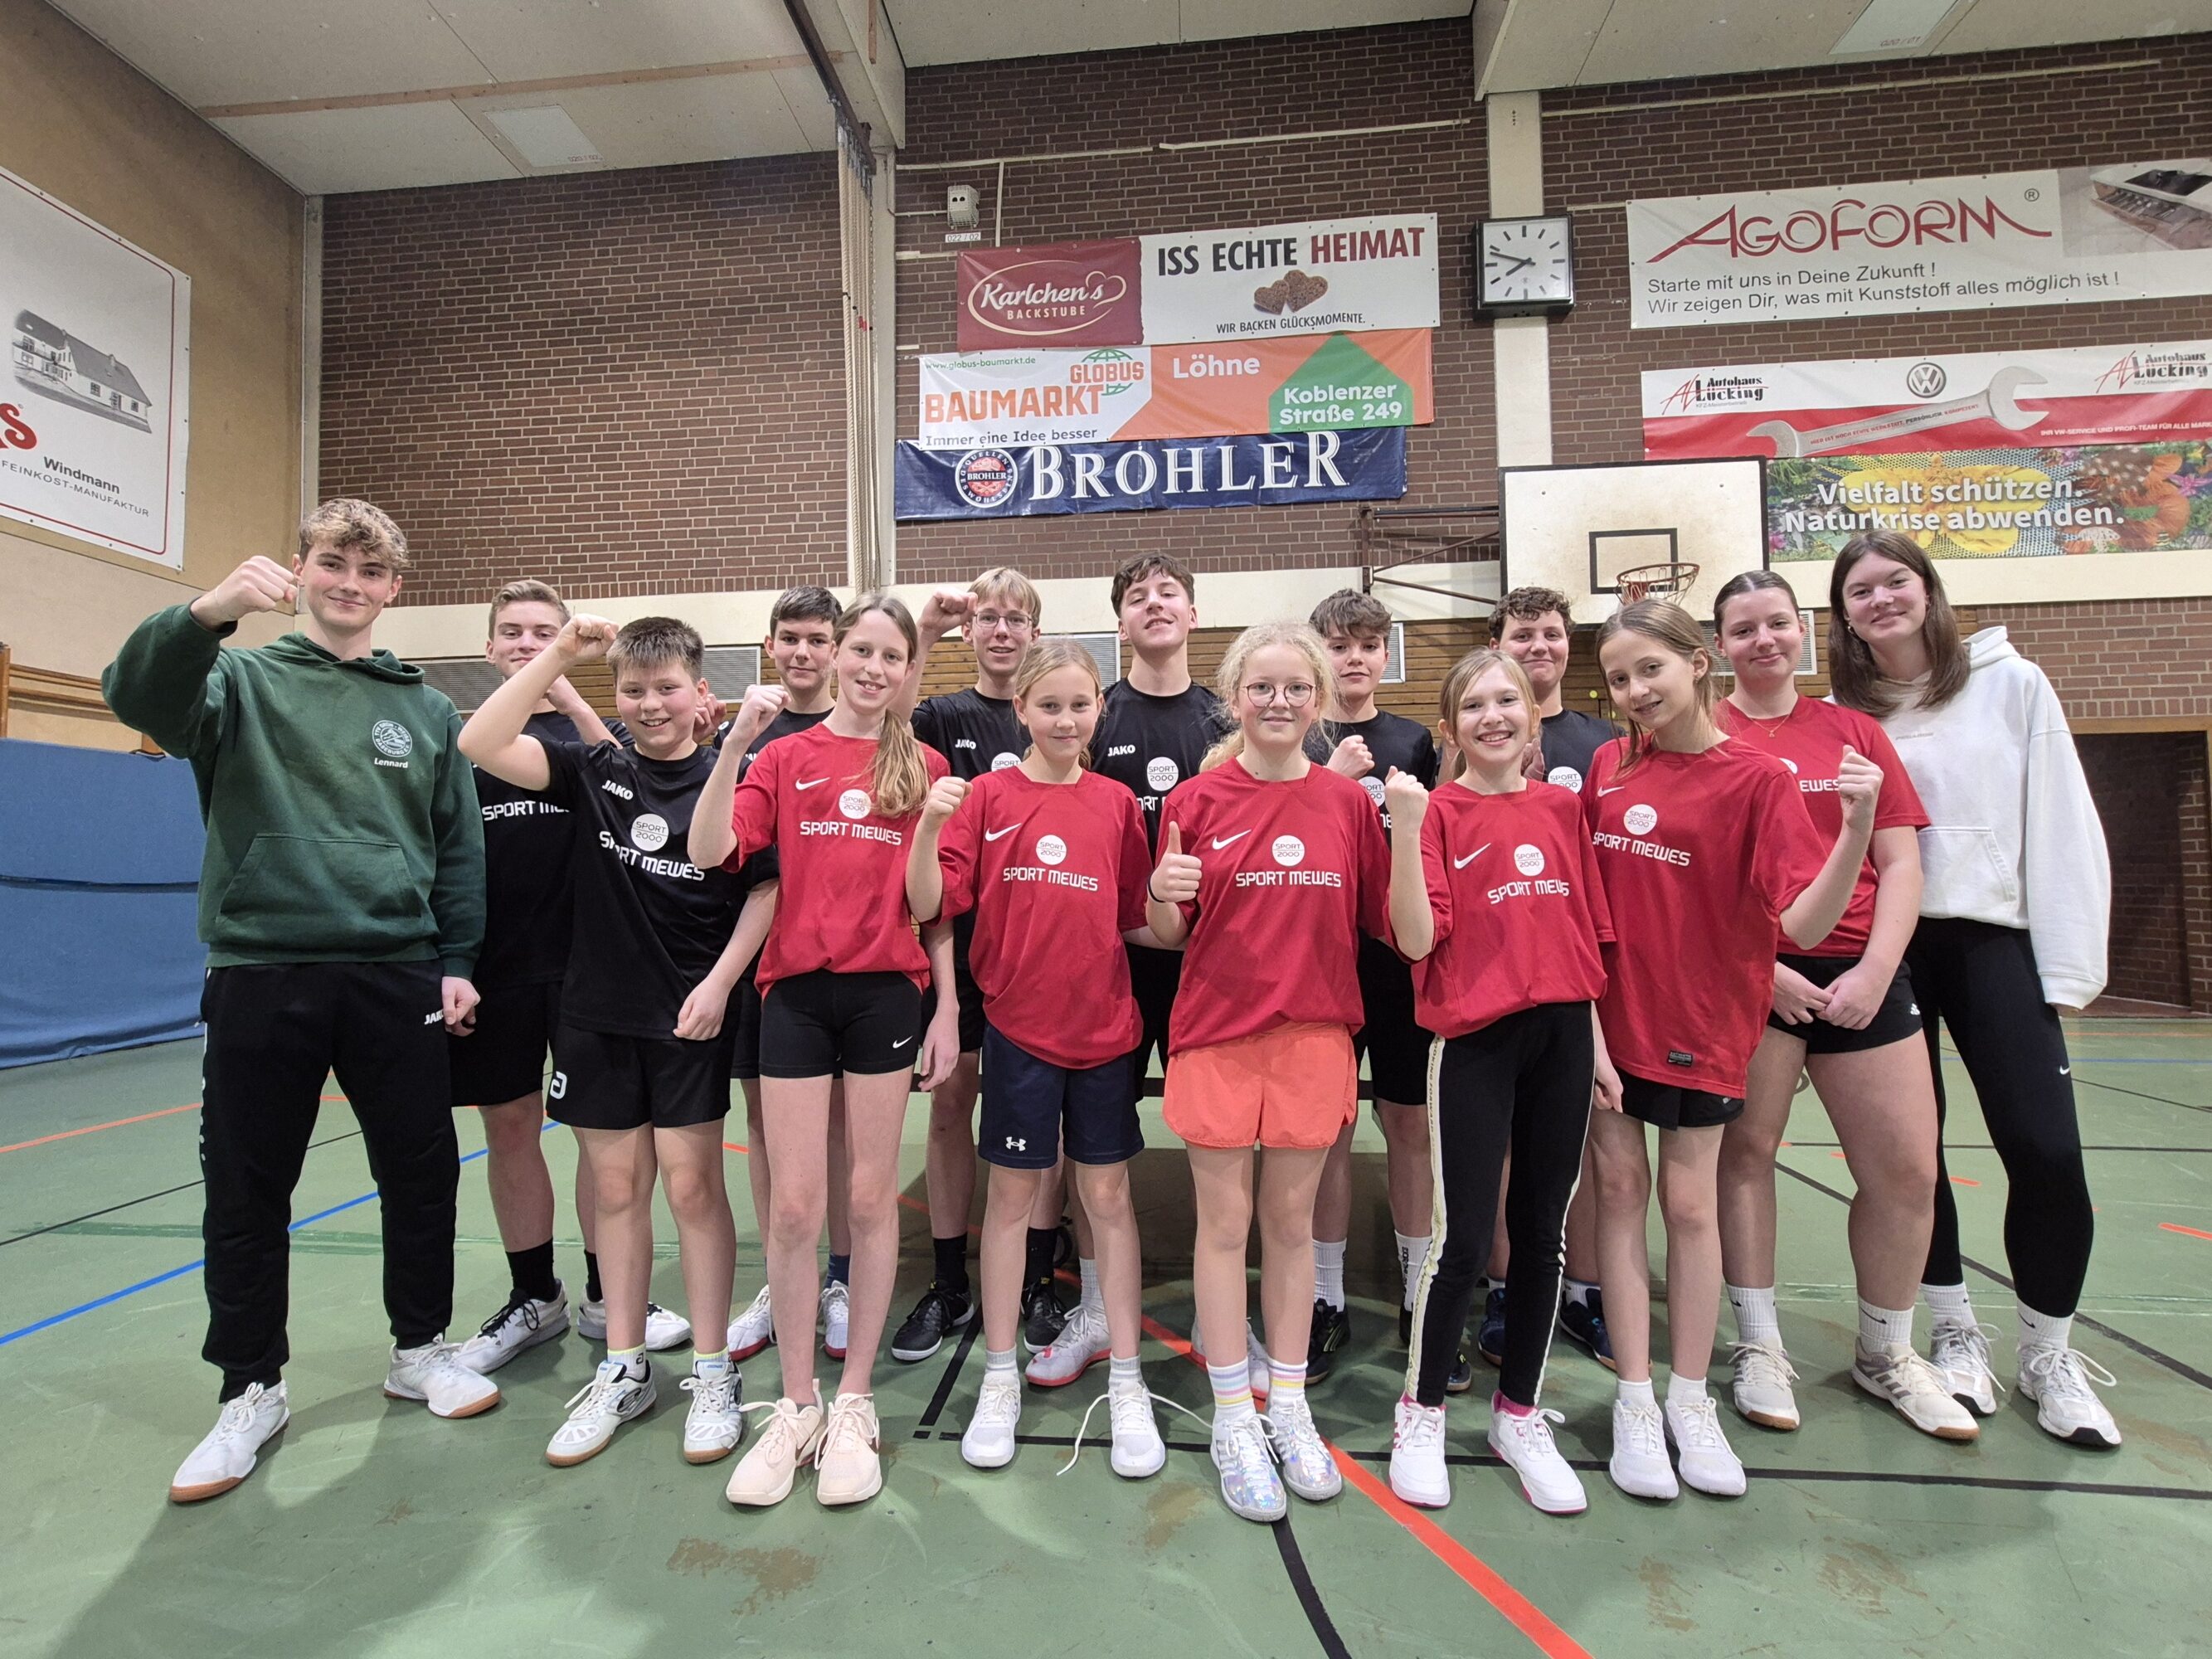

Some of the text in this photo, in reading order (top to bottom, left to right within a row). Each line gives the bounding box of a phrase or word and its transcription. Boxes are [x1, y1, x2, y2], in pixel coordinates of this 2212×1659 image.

[1646, 195, 2052, 263] AGOFORM
[1159, 227, 1425, 276] ISS ECHTE HEIMAT
[1648, 279, 1700, 293] Starte
[1707, 275, 1732, 290] mit
[1739, 275, 1772, 289] uns
[1777, 272, 1791, 285] in
[1798, 269, 1850, 284] Deine
[1856, 263, 1925, 281] Zukunft
[980, 282, 1105, 309] Karlchen's
[1648, 299, 1678, 314] Wir
[1684, 296, 1742, 314] zeigen
[1749, 293, 1777, 309] Dir,
[1785, 293, 1820, 305] was
[1826, 289, 1853, 304] mit
[1860, 282, 1950, 301] Kunststoff
[1957, 281, 1999, 295] alles
[2006, 274, 2080, 294] möglich
[2087, 272, 2109, 287] ist
[1007, 305, 1086, 320] BACKSTUBE
[1216, 313, 1365, 333] WIR BACKEN GLÜCKSMOMENTE.
[925, 357, 1036, 371] www.globus-baumarkt.de
[1173, 354, 1261, 378] Löhne
[2145, 353, 2206, 363] Autohaus
[1070, 361, 1145, 383] GLOBUS
[1707, 377, 1762, 387] Autohaus
[1285, 384, 1397, 405] Koblenzer
[1695, 380, 1763, 401] Lücking
[925, 384, 1104, 423] BAUMARKT
[1280, 401, 1403, 426] Straße 249
[926, 429, 1097, 446] Immer eine Idee besser
[965, 451, 1009, 465] QUELLEN
[1028, 431, 1350, 501] BROHLER
[43, 455, 121, 495] Windmann
[967, 472, 1007, 480] BROHLER
[2, 460, 149, 518] FEINKOST-MANUFAKTUR
[1817, 478, 2083, 506] Vielfalt schützen.
[1785, 503, 2124, 533] Naturkrise abwenden.
[955, 739, 977, 750] JAKO
[1107, 745, 1136, 757] JAKO
[374, 757, 408, 768] Lennard
[601, 779, 634, 800] JAKO
[1799, 780, 1840, 791] EWES
[481, 800, 536, 821] SPORT
[1630, 810, 1655, 820] SPORT
[636, 821, 667, 834] SPORT
[800, 821, 902, 846] SPORT MEWES
[1627, 820, 1650, 828] 2000
[635, 831, 663, 843] 2000
[1040, 841, 1063, 851] SPORT
[1040, 849, 1062, 858] 2000
[1592, 831, 1691, 867] SPORT MEWES
[641, 855, 705, 882] MEWES
[1236, 870, 1341, 888] SPORT MEWES
[1003, 867, 1099, 892] SPORT MEWES
[1487, 881, 1531, 905] SPORT
[424, 1009, 444, 1025] JAK
